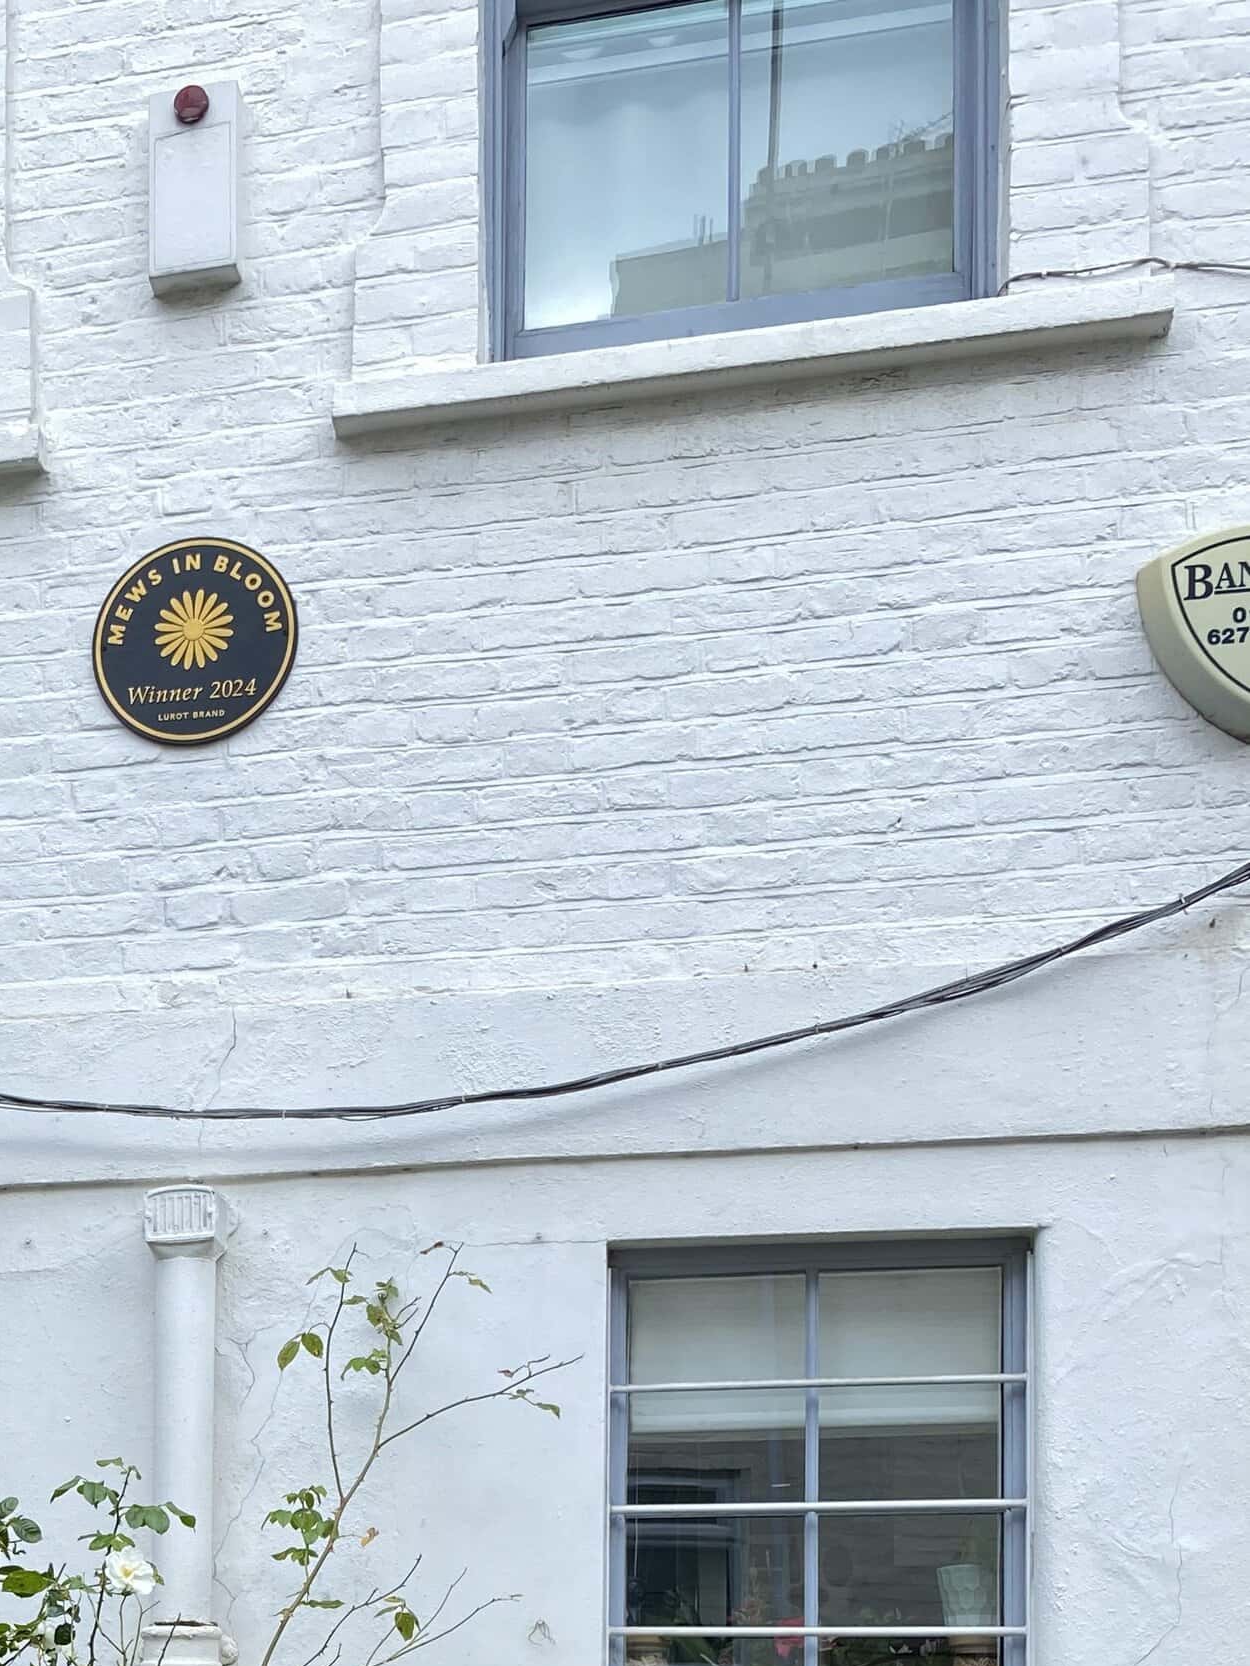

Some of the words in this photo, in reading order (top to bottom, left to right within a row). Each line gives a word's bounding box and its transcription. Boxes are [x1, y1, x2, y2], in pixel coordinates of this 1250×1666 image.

[107, 568, 163, 646] MEWS
[172, 553, 201, 575] IN
[213, 554, 283, 633] BLOOM
[1232, 606, 1250, 624] 0
[1207, 626, 1250, 646] 627
[128, 684, 204, 706] Winner
[209, 677, 258, 700] 2024
[192, 709, 226, 720] BRAND
